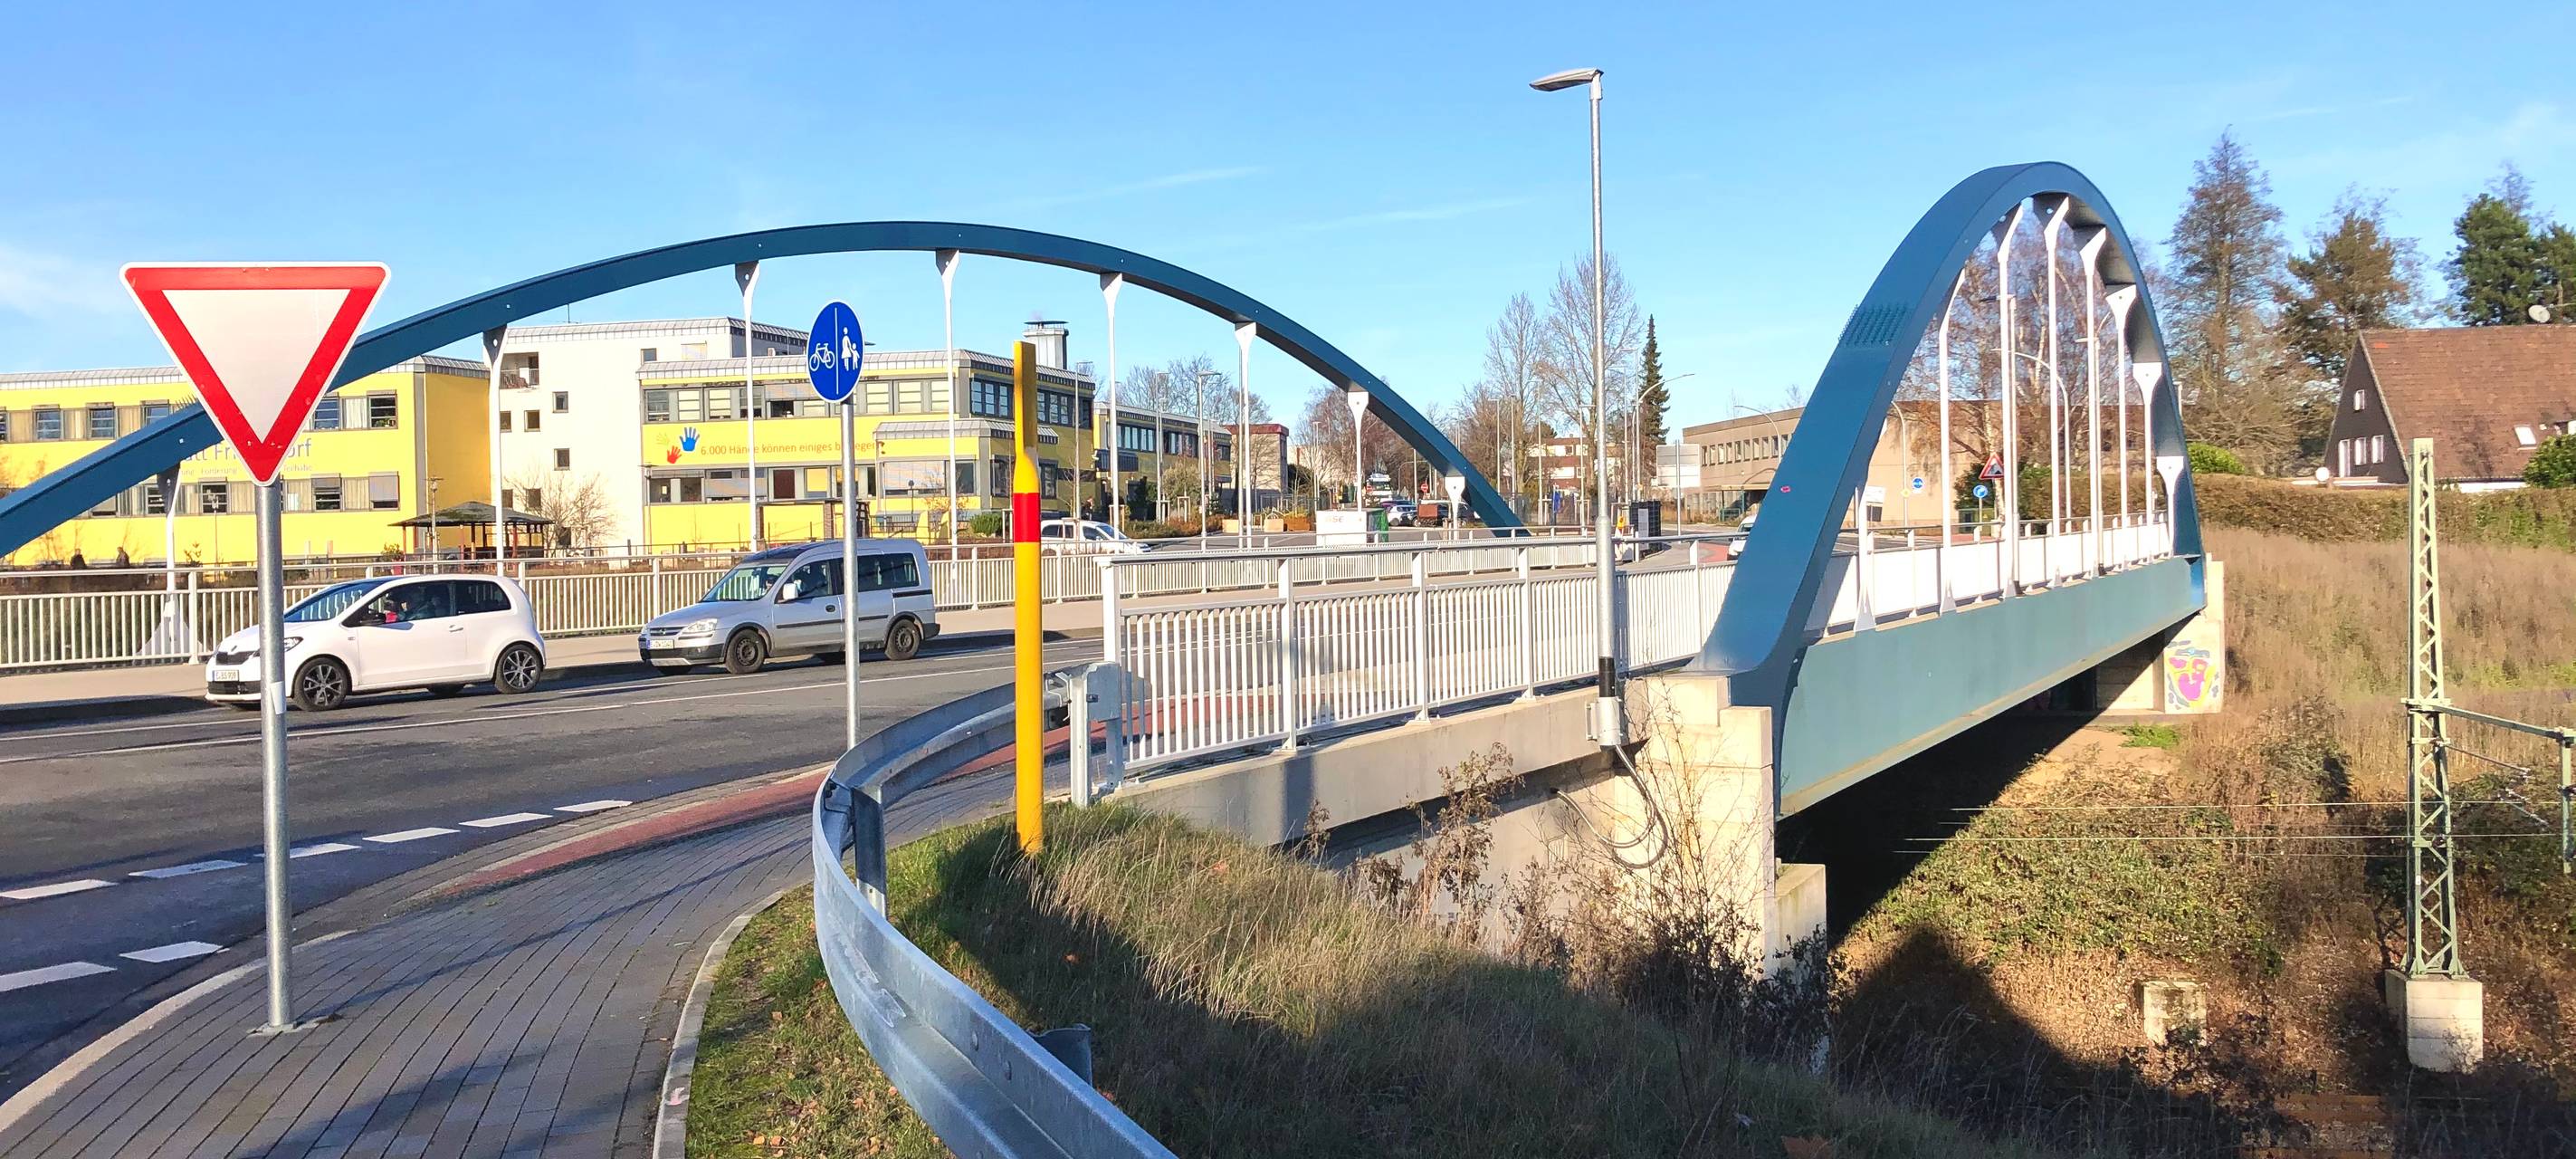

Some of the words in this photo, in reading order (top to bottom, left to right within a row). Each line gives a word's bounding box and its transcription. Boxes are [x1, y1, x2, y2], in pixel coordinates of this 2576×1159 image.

[701, 445, 727, 455] 6.000
[761, 442, 797, 454] können
[798, 441, 833, 454] einiges
